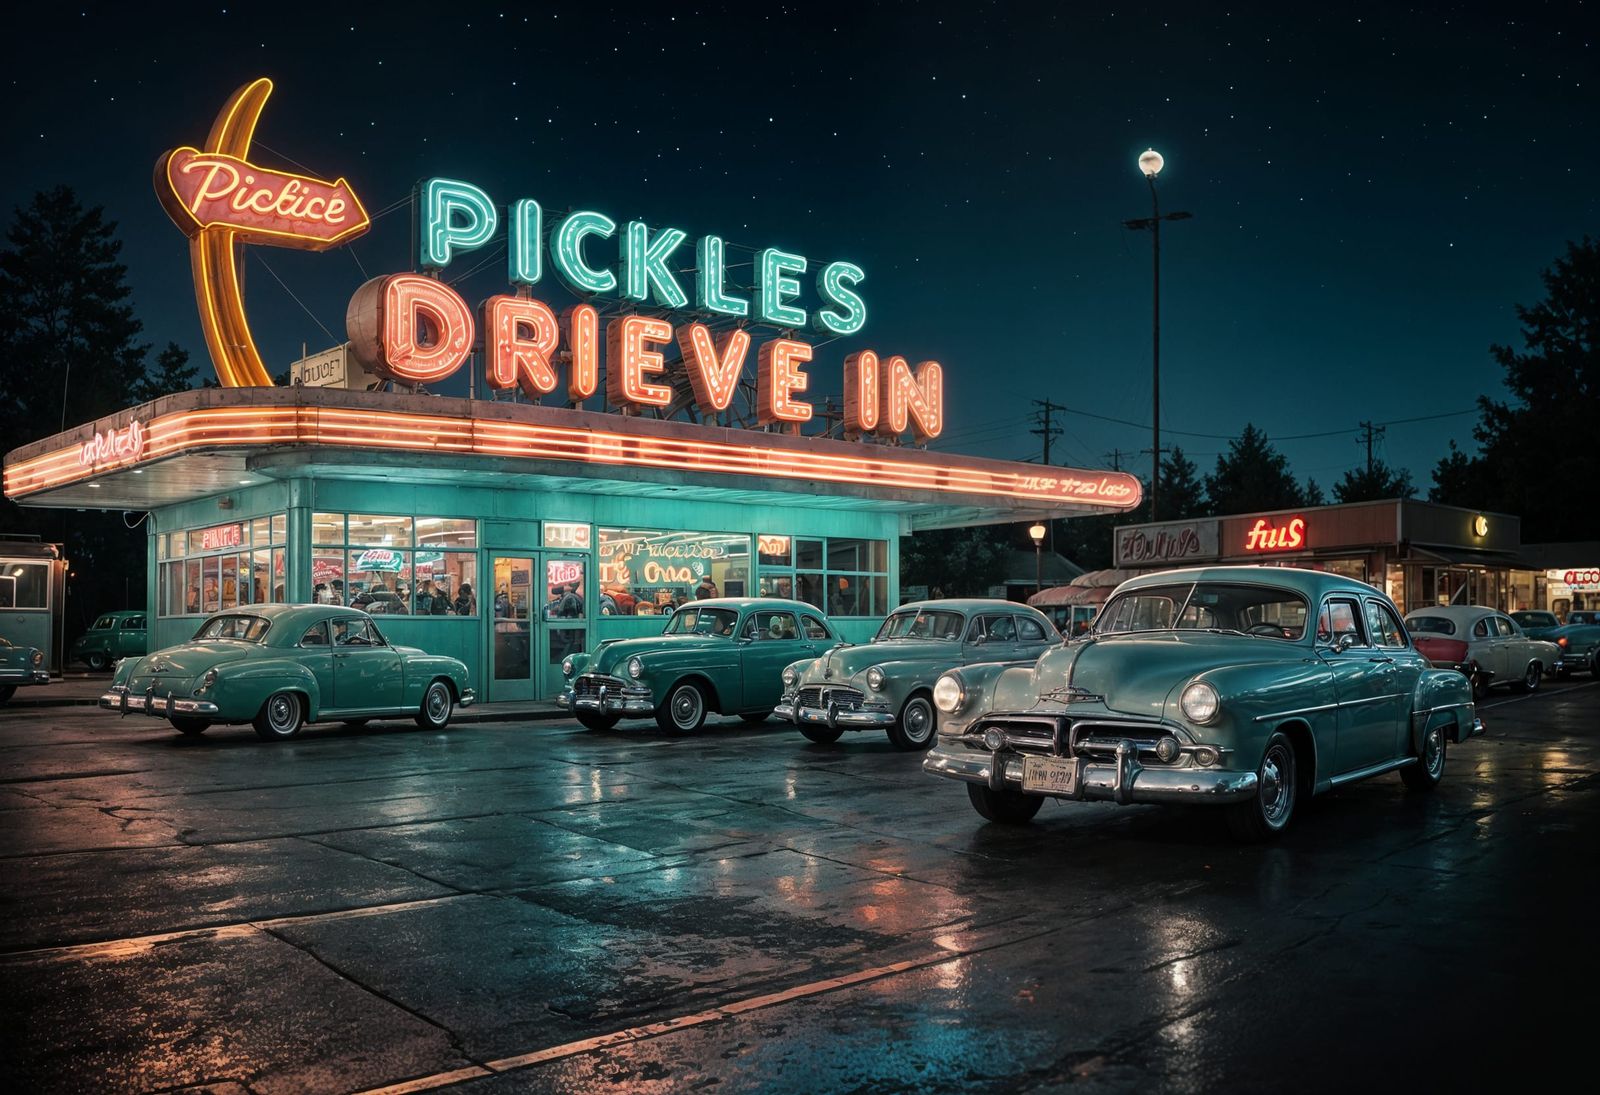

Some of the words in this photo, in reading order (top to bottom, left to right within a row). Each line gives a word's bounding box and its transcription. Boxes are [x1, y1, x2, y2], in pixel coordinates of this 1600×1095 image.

[421, 177, 867, 336] PICKLES
[376, 272, 814, 424] DRIEVE
[847, 349, 945, 440] IN
